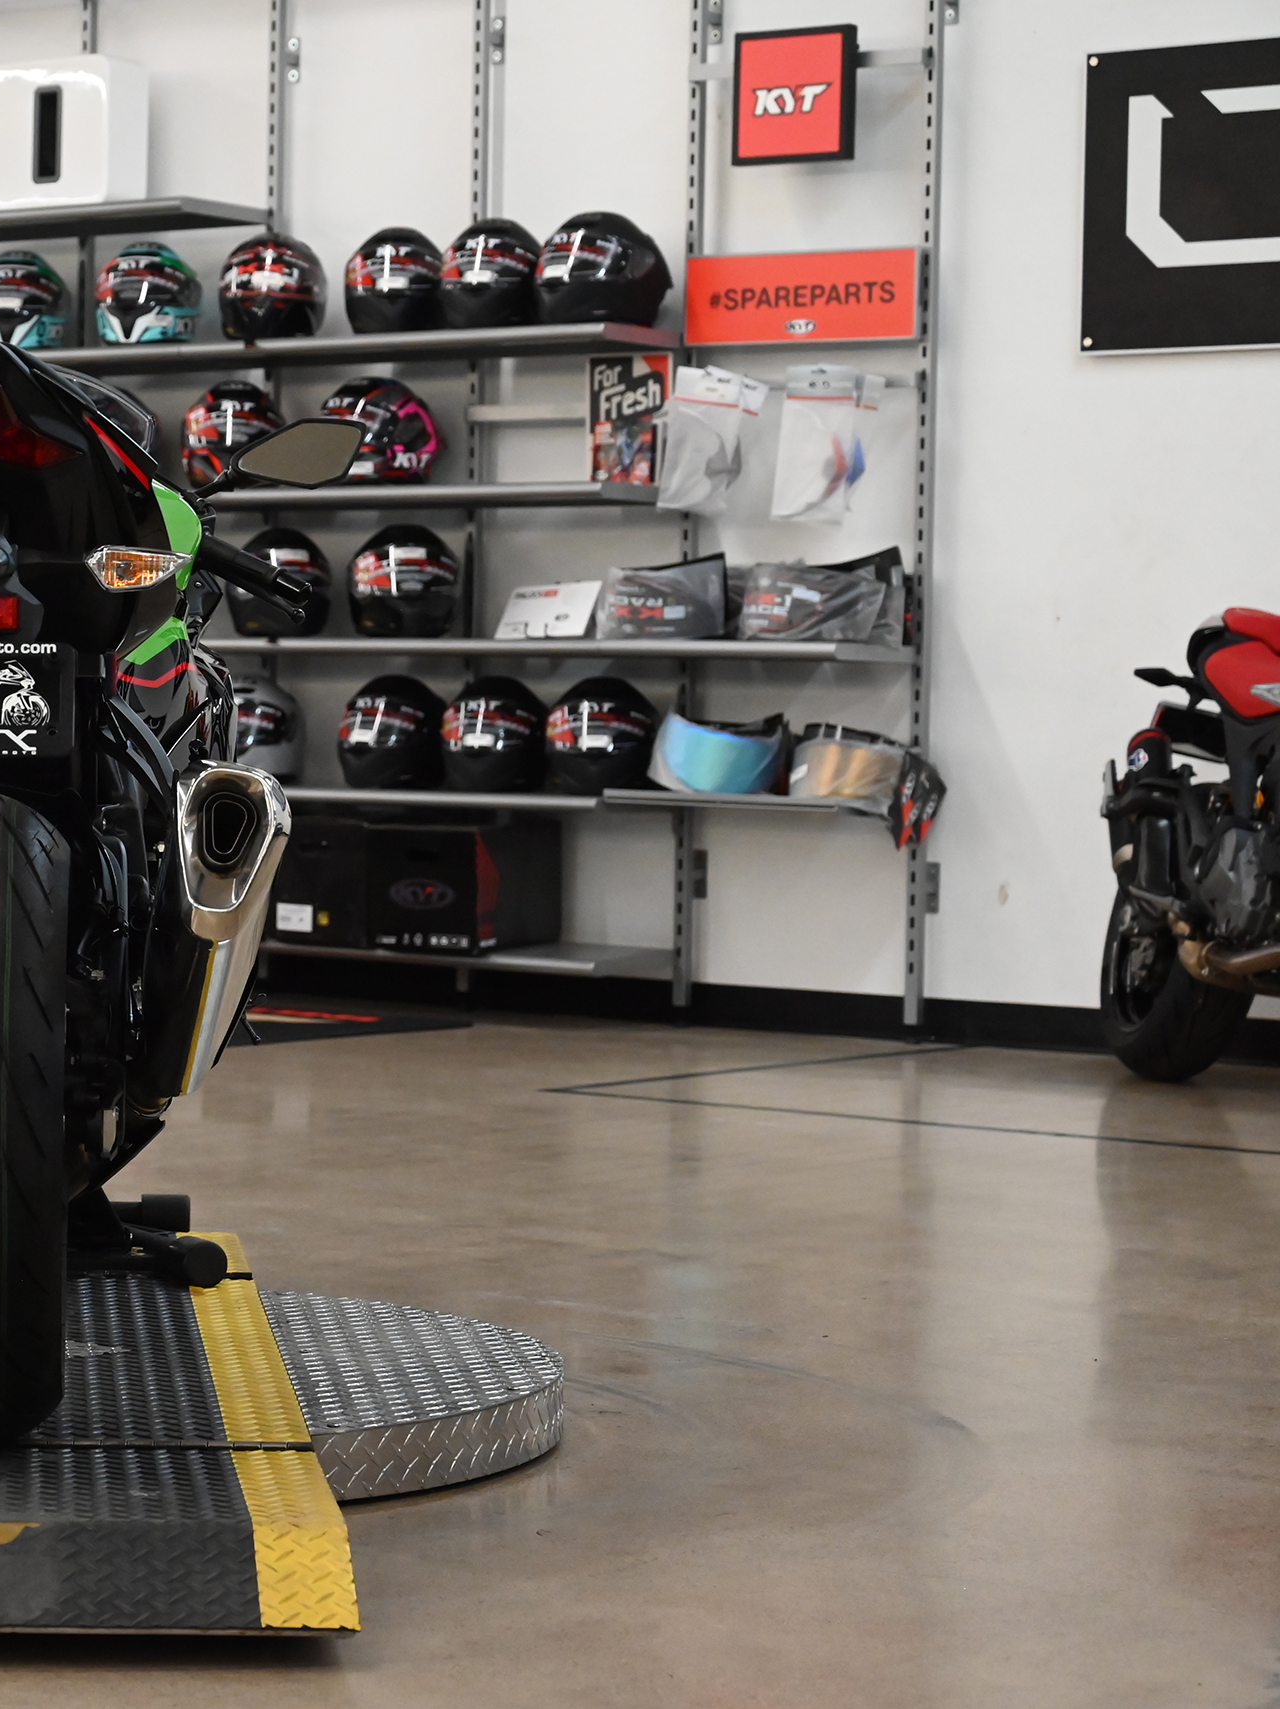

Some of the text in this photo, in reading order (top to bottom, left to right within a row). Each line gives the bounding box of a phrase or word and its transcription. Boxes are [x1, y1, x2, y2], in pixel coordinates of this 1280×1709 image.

[752, 83, 832, 116] KYT
[710, 280, 896, 311] #SPAREPARTS
[593, 364, 623, 391] For
[599, 378, 662, 420] Fresh
